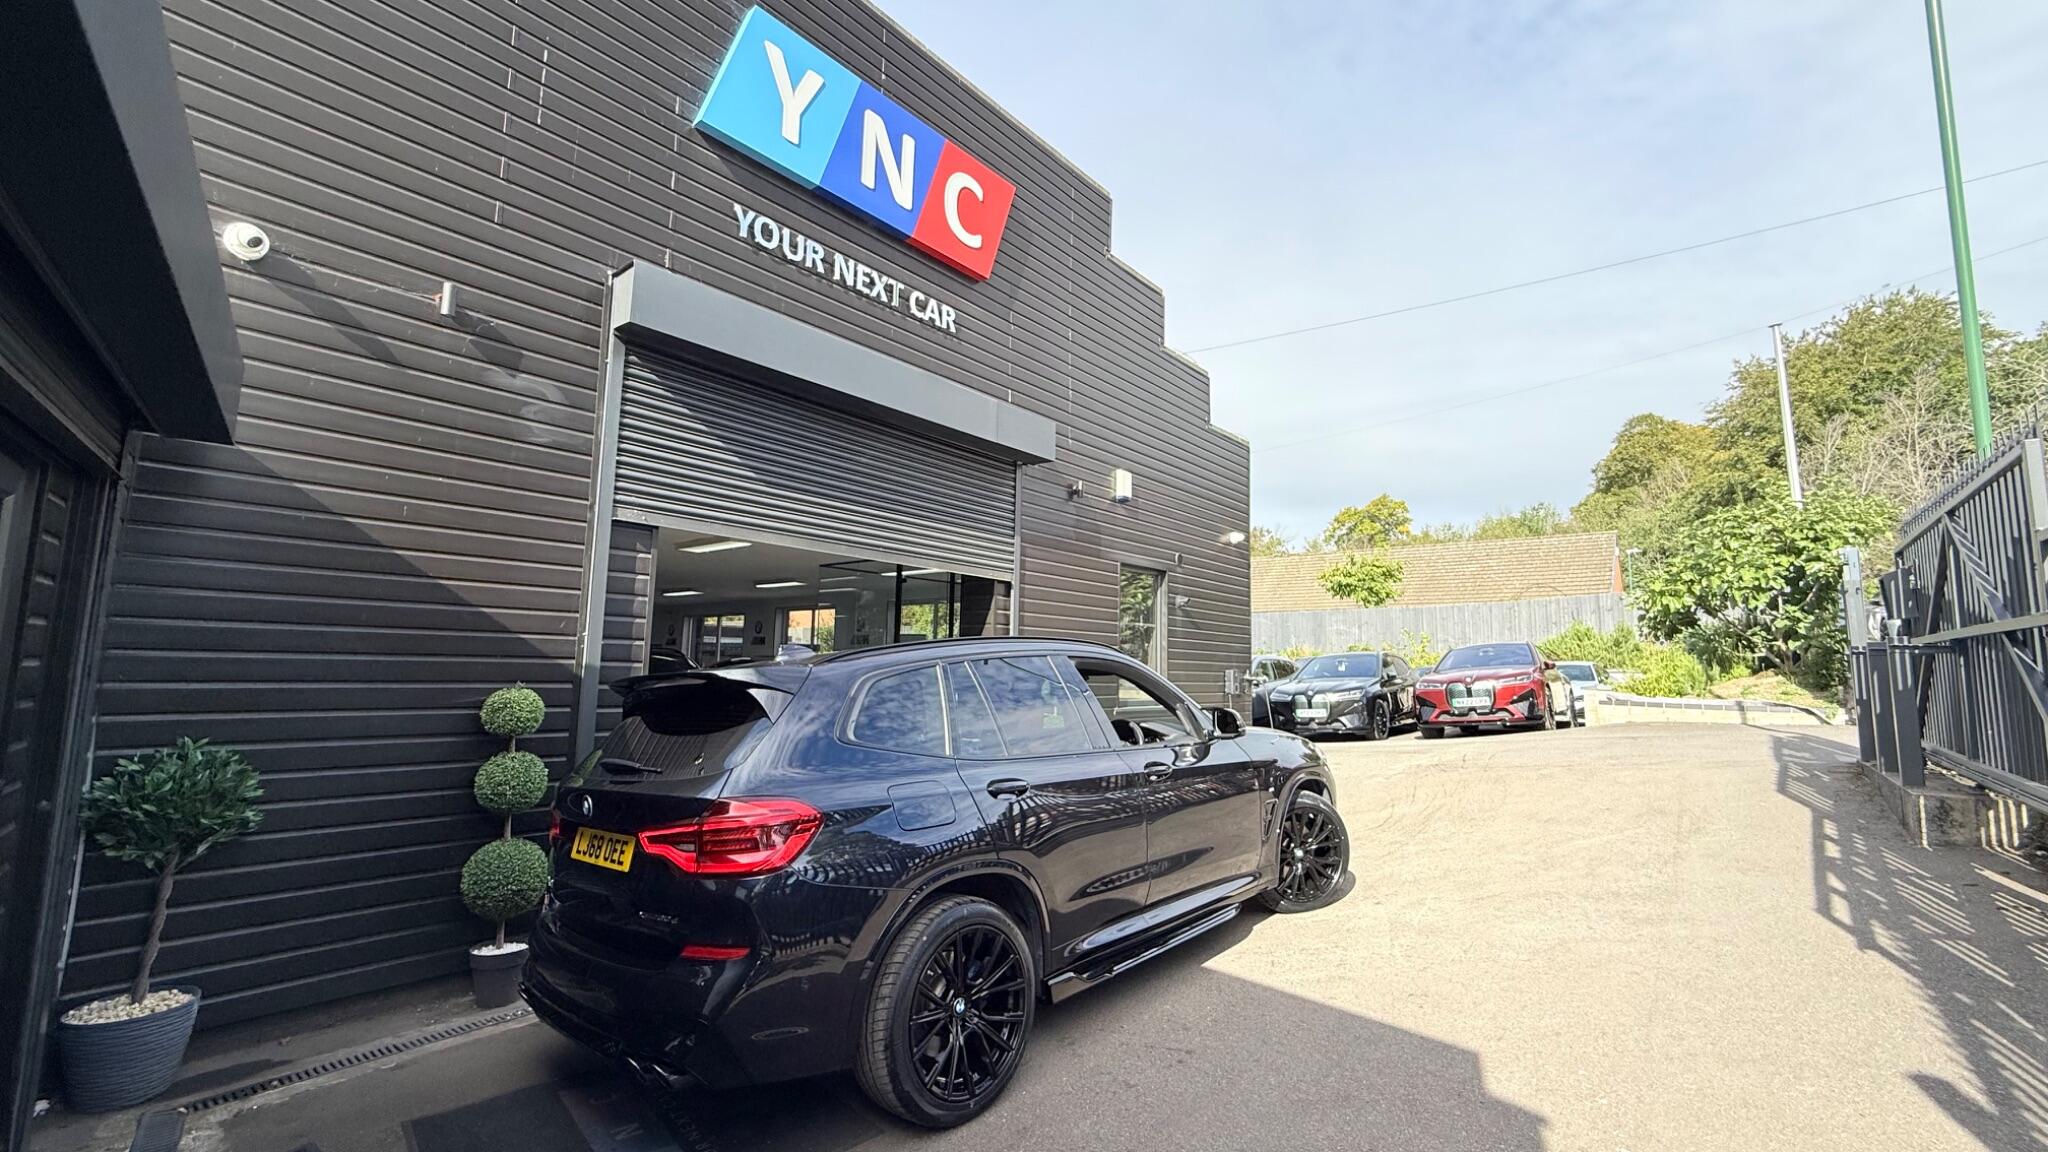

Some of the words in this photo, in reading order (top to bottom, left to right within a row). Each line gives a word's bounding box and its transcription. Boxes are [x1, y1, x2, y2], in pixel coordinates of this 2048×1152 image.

[764, 39, 984, 249] YNC
[734, 202, 825, 274] YOUR
[833, 253, 904, 307] NEXT
[909, 291, 957, 333] CAR
